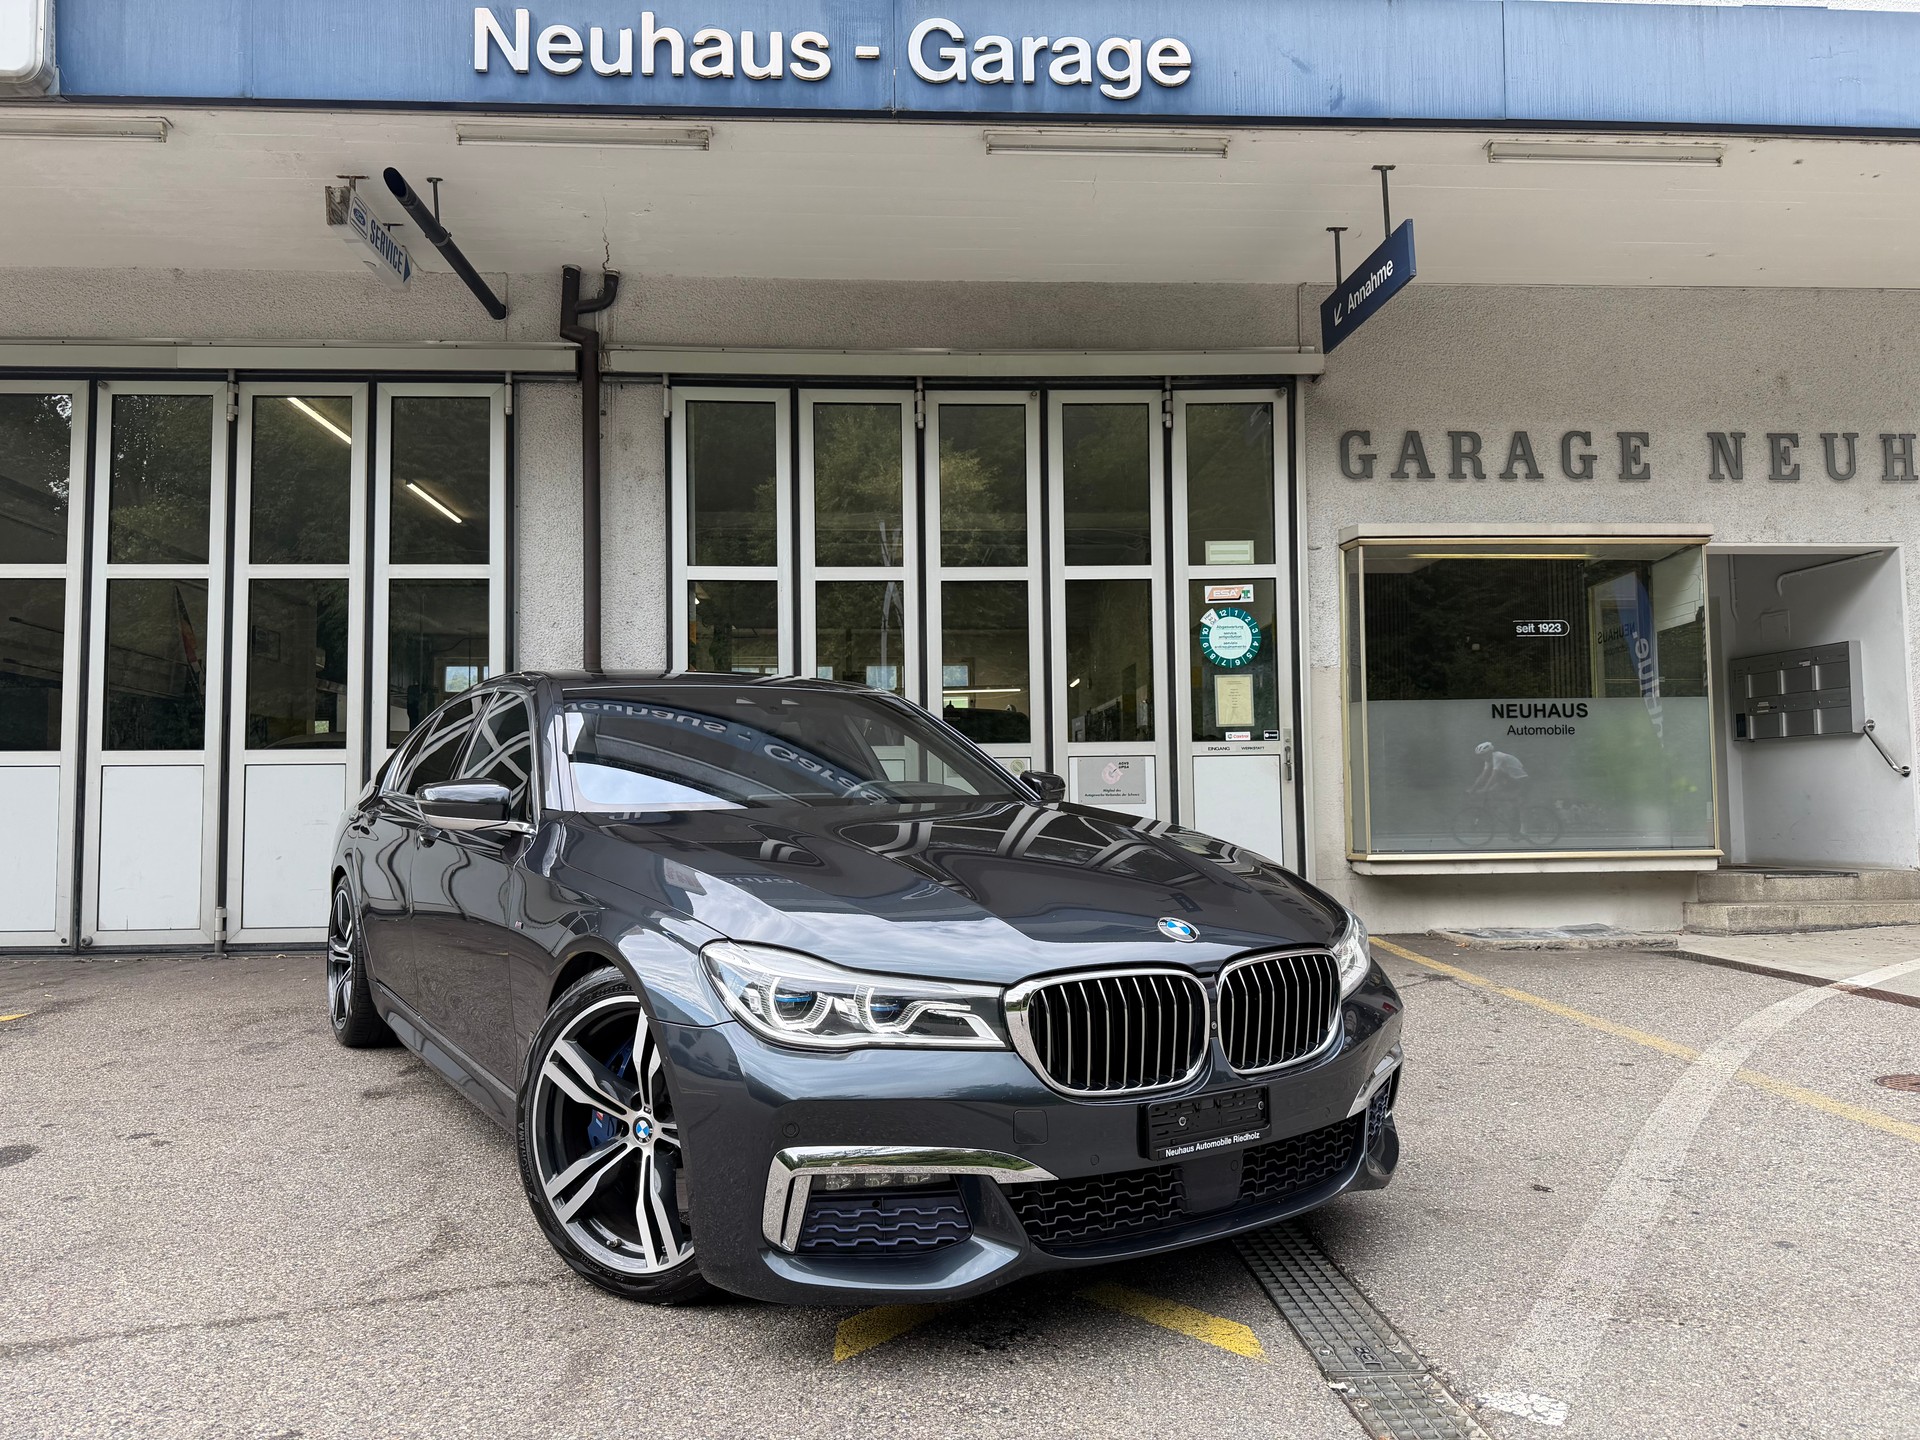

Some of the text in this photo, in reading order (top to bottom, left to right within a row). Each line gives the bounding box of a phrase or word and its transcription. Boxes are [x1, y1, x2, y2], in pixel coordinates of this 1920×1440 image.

[474, 7, 1193, 100] Neuhaus - Garage
[370, 219, 404, 275] SERVICE
[1347, 259, 1394, 314] Annahme
[1339, 430, 1918, 481] GARAGE NEUH
[1515, 623, 1562, 633] seit 1923
[1491, 703, 1589, 719] NEUHAUS
[1506, 725, 1576, 736] Automobile
[1165, 1131, 1261, 1158] Neuhaus Automobile Riedholz
